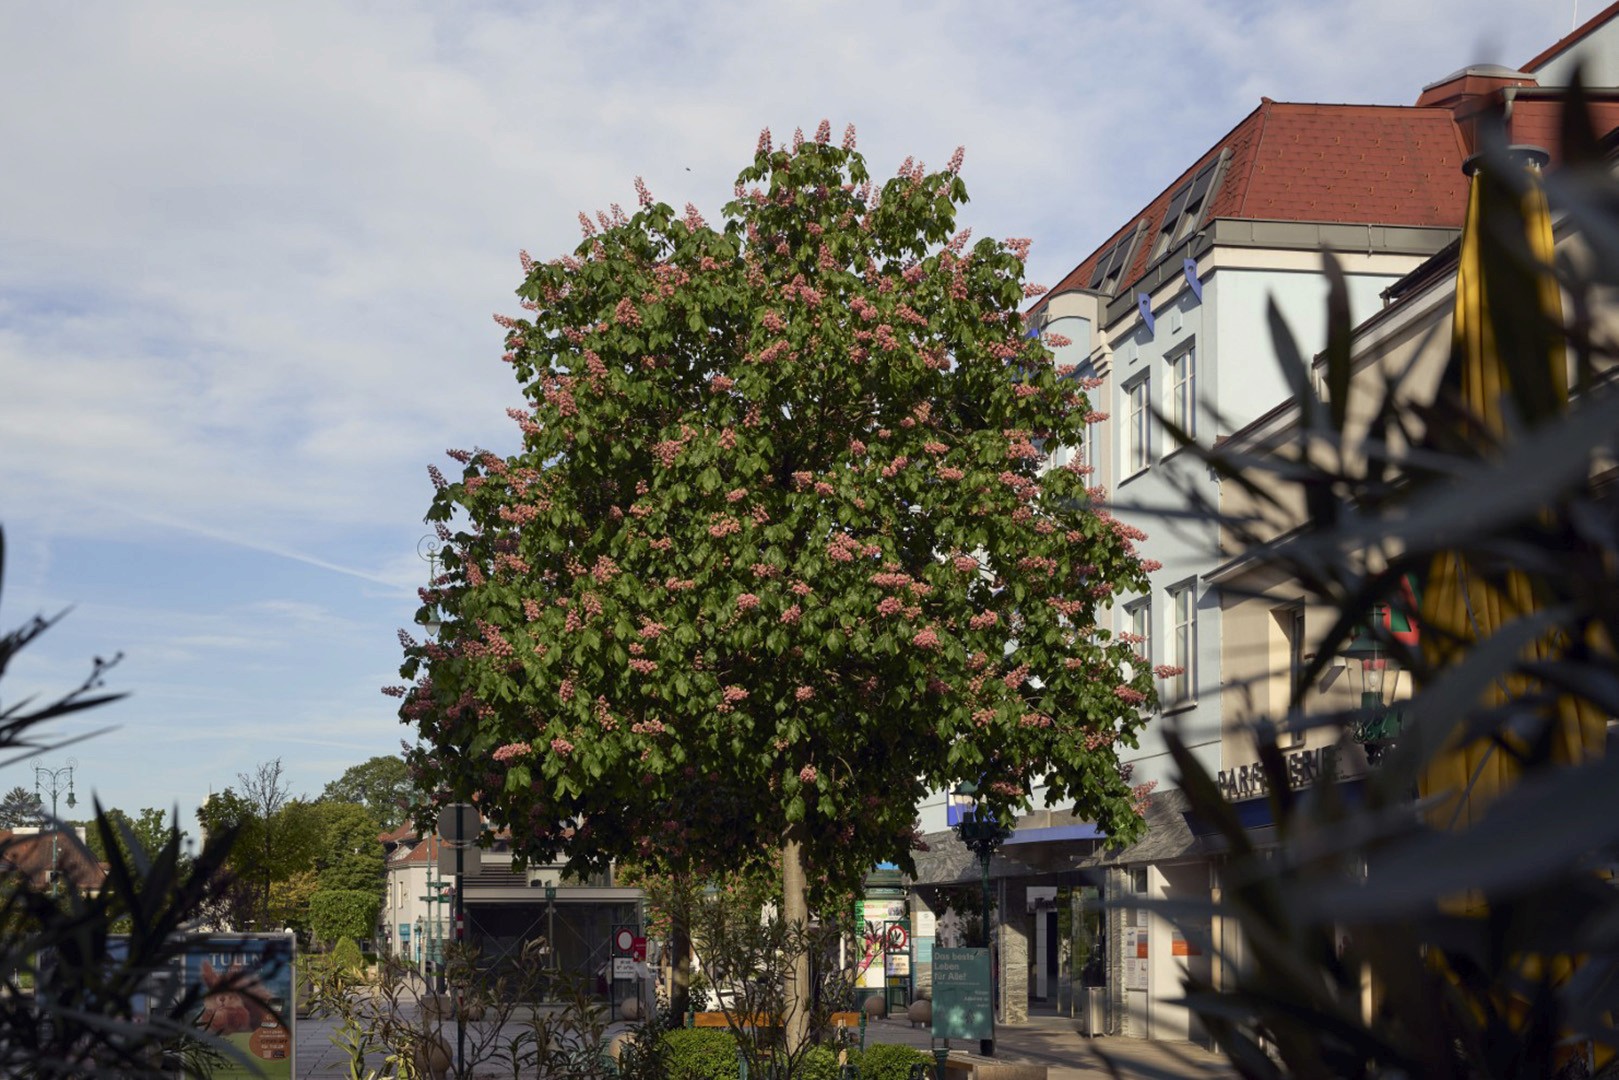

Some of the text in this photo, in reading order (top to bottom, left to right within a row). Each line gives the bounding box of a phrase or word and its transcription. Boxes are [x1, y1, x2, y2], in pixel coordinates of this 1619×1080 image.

[934, 952, 950, 960] Das
[952, 952, 974, 960] beste
[934, 962, 959, 970] Leben
[934, 972, 945, 980] für
